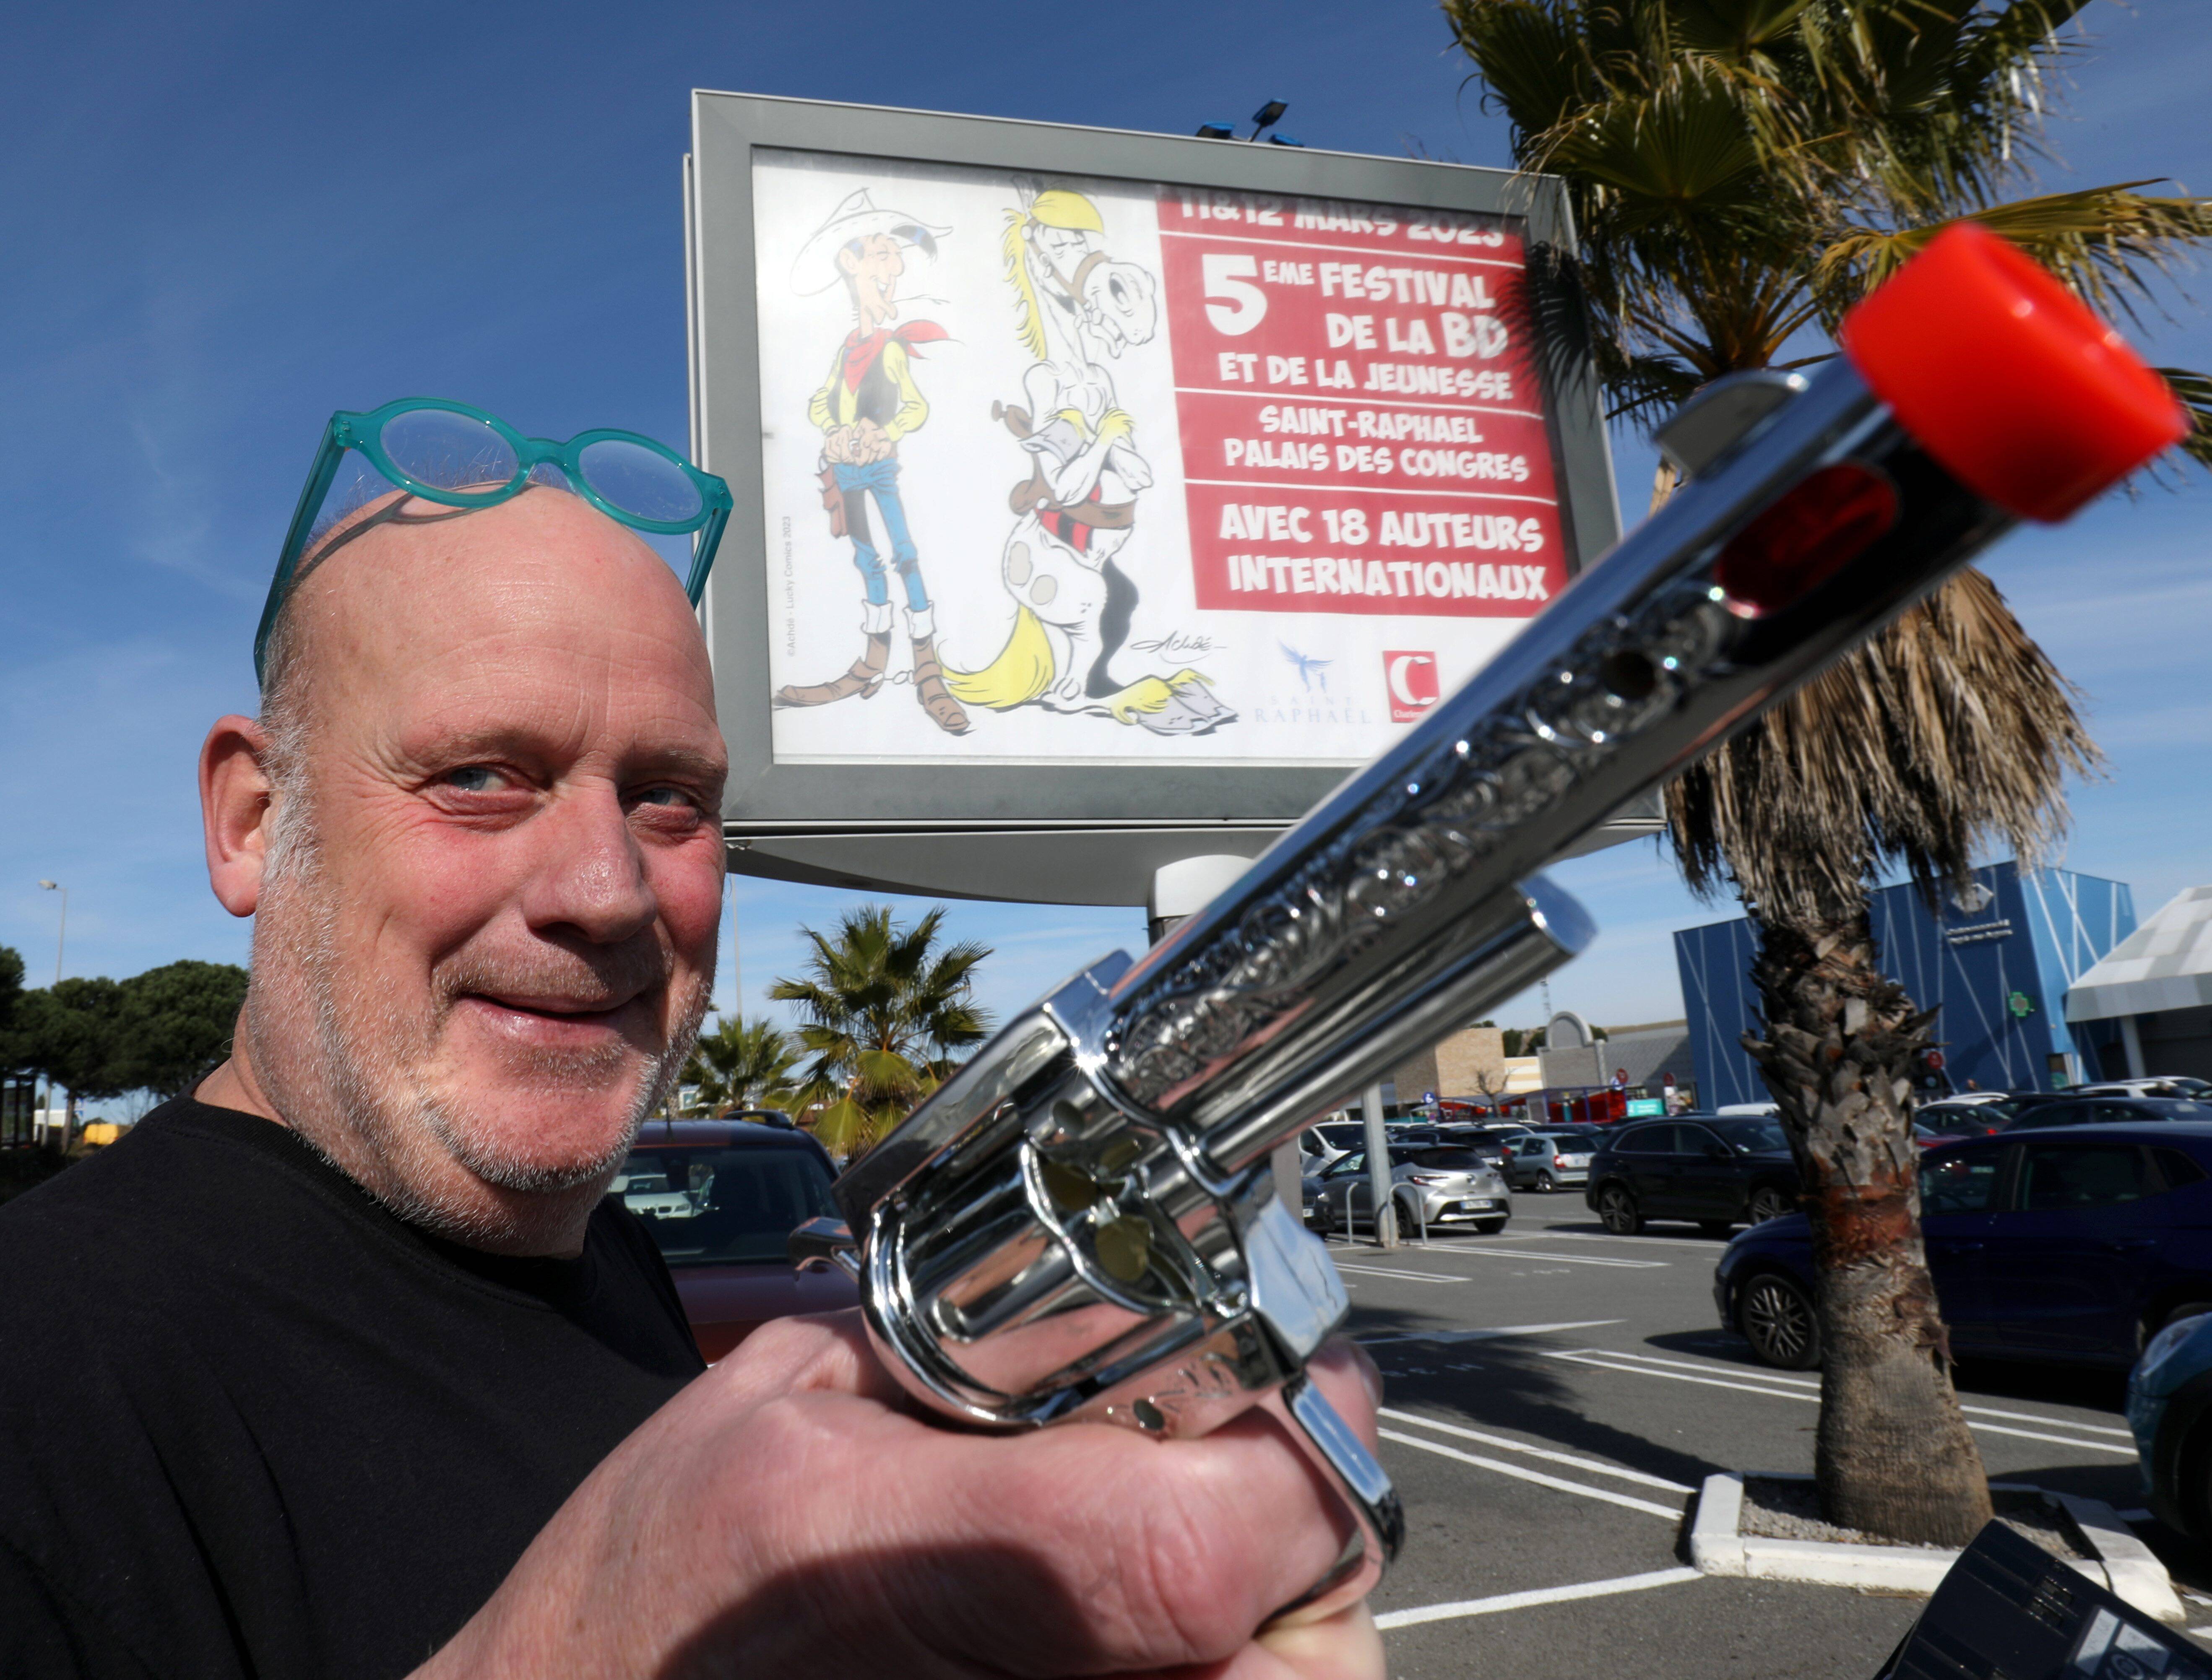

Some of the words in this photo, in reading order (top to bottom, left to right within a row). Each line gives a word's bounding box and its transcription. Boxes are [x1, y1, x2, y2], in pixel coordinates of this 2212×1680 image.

[1295, 198, 1398, 235] MARS
[1407, 209, 1504, 248] 2023
[1320, 262, 1495, 309] FESTIVAL
[1326, 313, 1377, 351] DE
[1386, 317, 1434, 355] LA
[1441, 312, 1508, 359] BD
[1218, 352, 1258, 382] ET
[1267, 356, 1308, 385] DE
[1315, 359, 1356, 389] LA
[1364, 363, 1513, 400] JEUNESSE
[1259, 405, 1483, 444] SAINT-RAPHAEL
[1224, 438, 1329, 471] PALAIS
[1337, 445, 1393, 475] DES
[1400, 449, 1530, 482] CONGRES
[782, 516, 791, 538] 2023
[1219, 504, 1314, 543] AVEC
[1322, 509, 1369, 546] 18
[1379, 511, 1544, 552] AUTEURS
[785, 580, 795, 609] Lucky
[1228, 555, 1549, 601] INTERNATIONAUX
